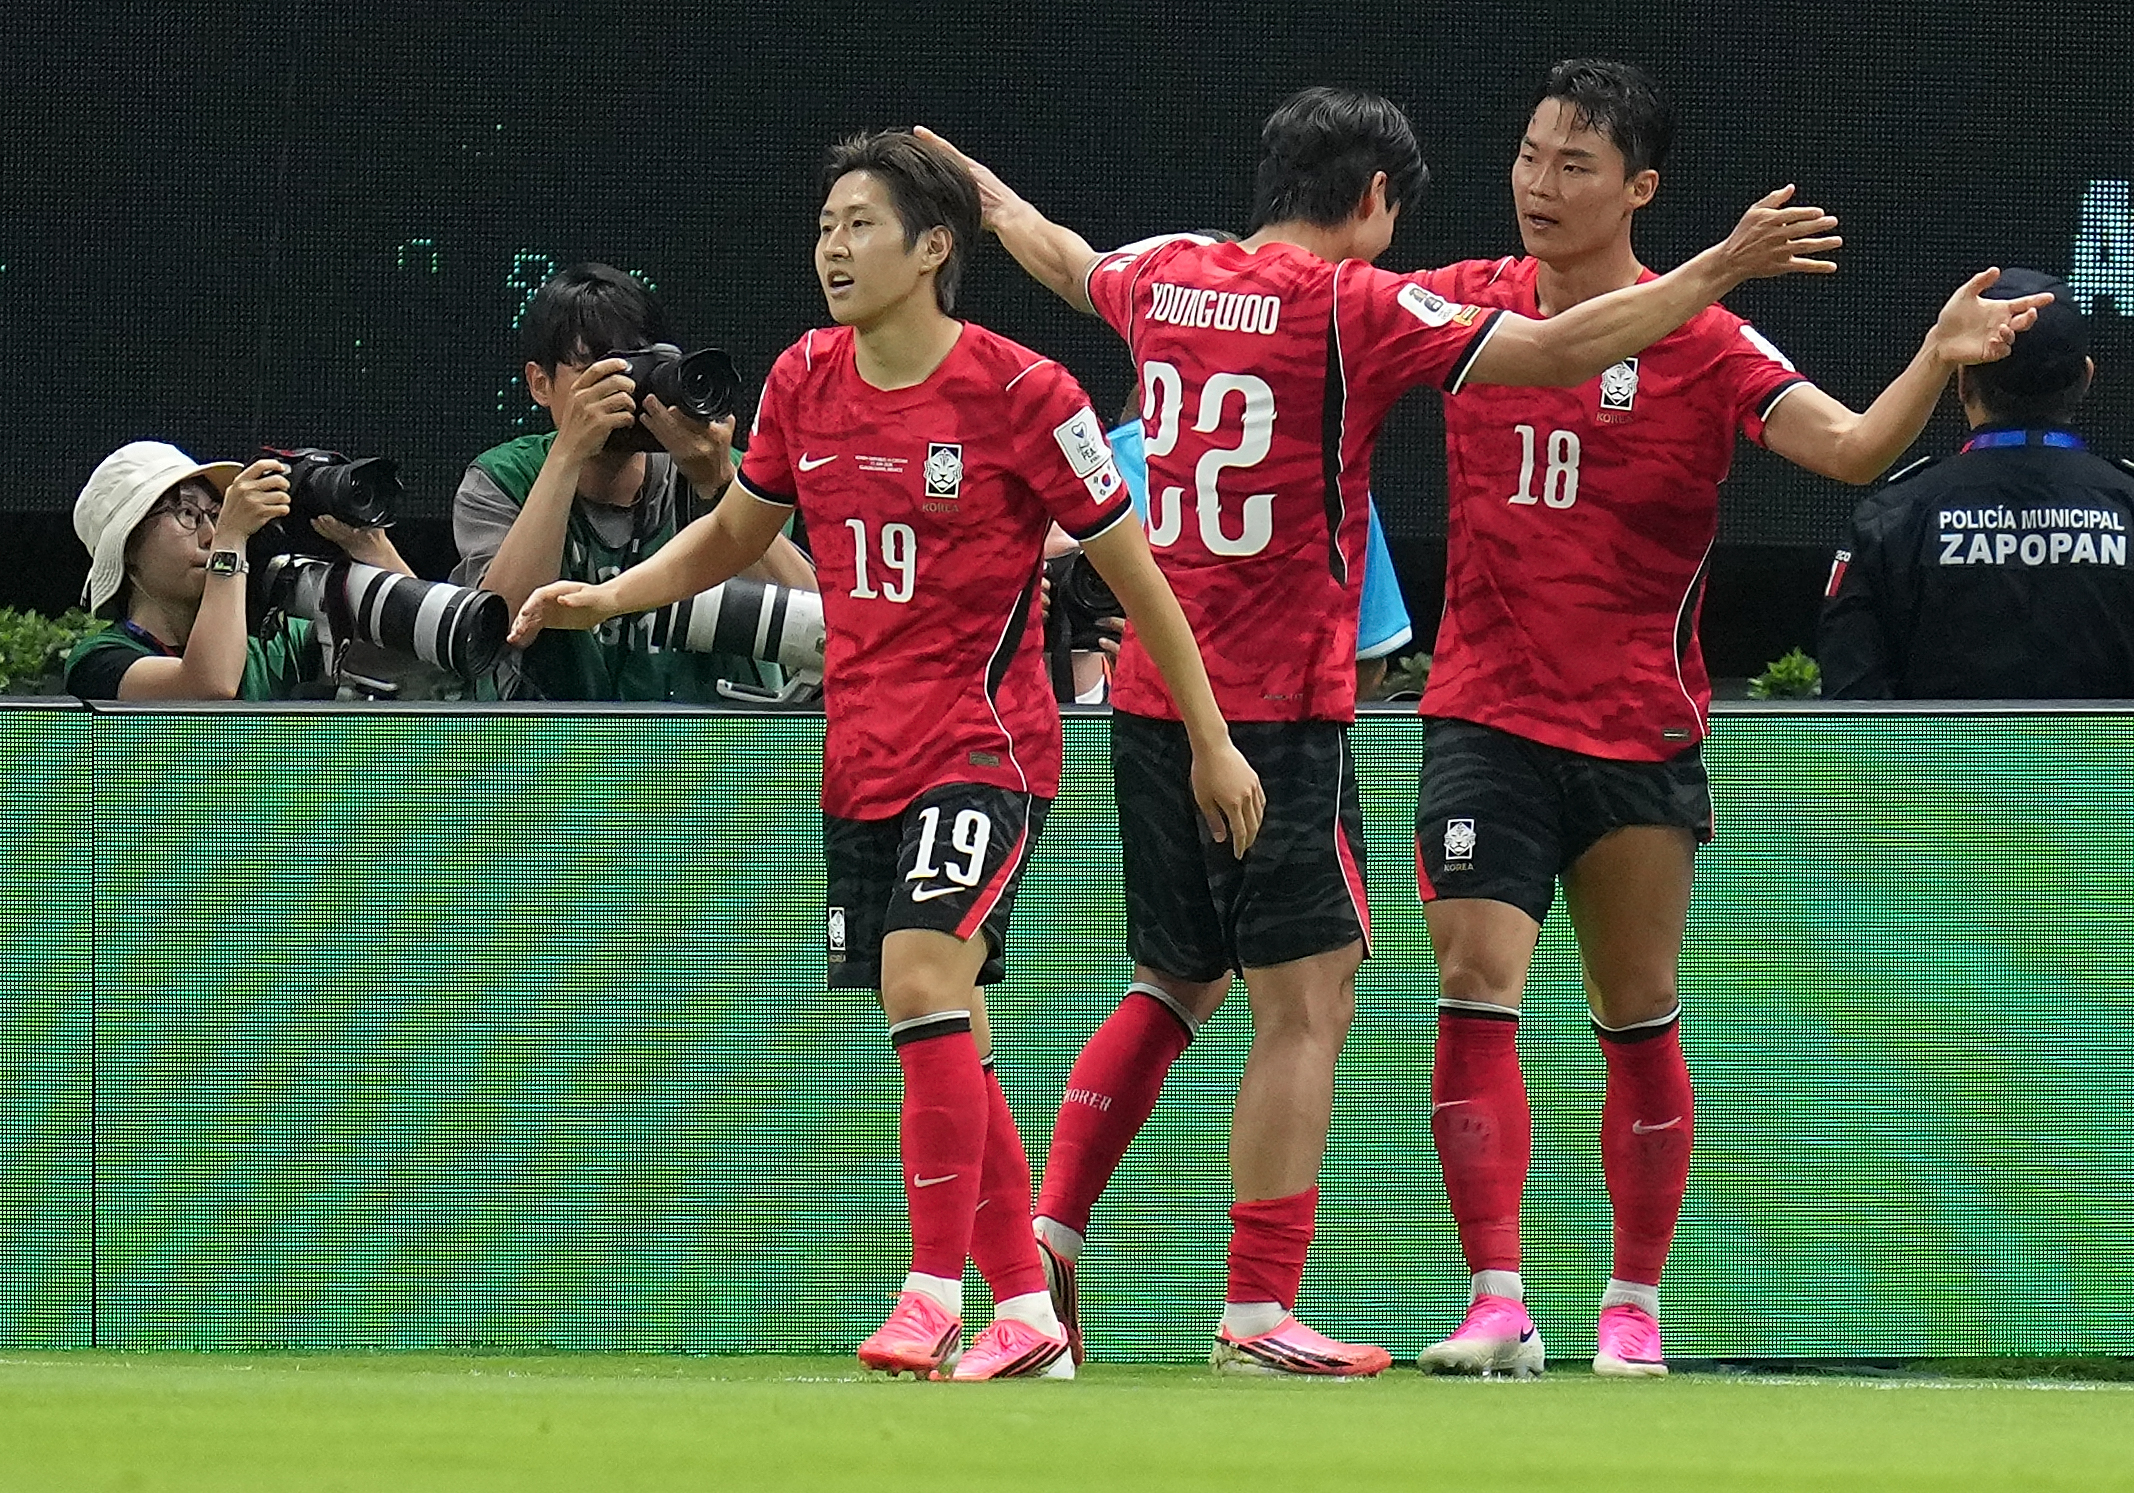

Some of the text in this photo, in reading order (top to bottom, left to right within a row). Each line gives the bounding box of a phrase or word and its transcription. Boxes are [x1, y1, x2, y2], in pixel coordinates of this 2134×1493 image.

[1145, 283, 1281, 335] YOUNGWOO
[1143, 360, 1278, 557] 22
[1507, 424, 1581, 509] 18
[922, 502, 960, 513] KOREA
[1939, 505, 2126, 531] POLICÍA MUNICIPAL
[845, 518, 917, 603] 19
[1939, 532, 2127, 566] ZAPOPAN
[905, 806, 991, 887] 19
